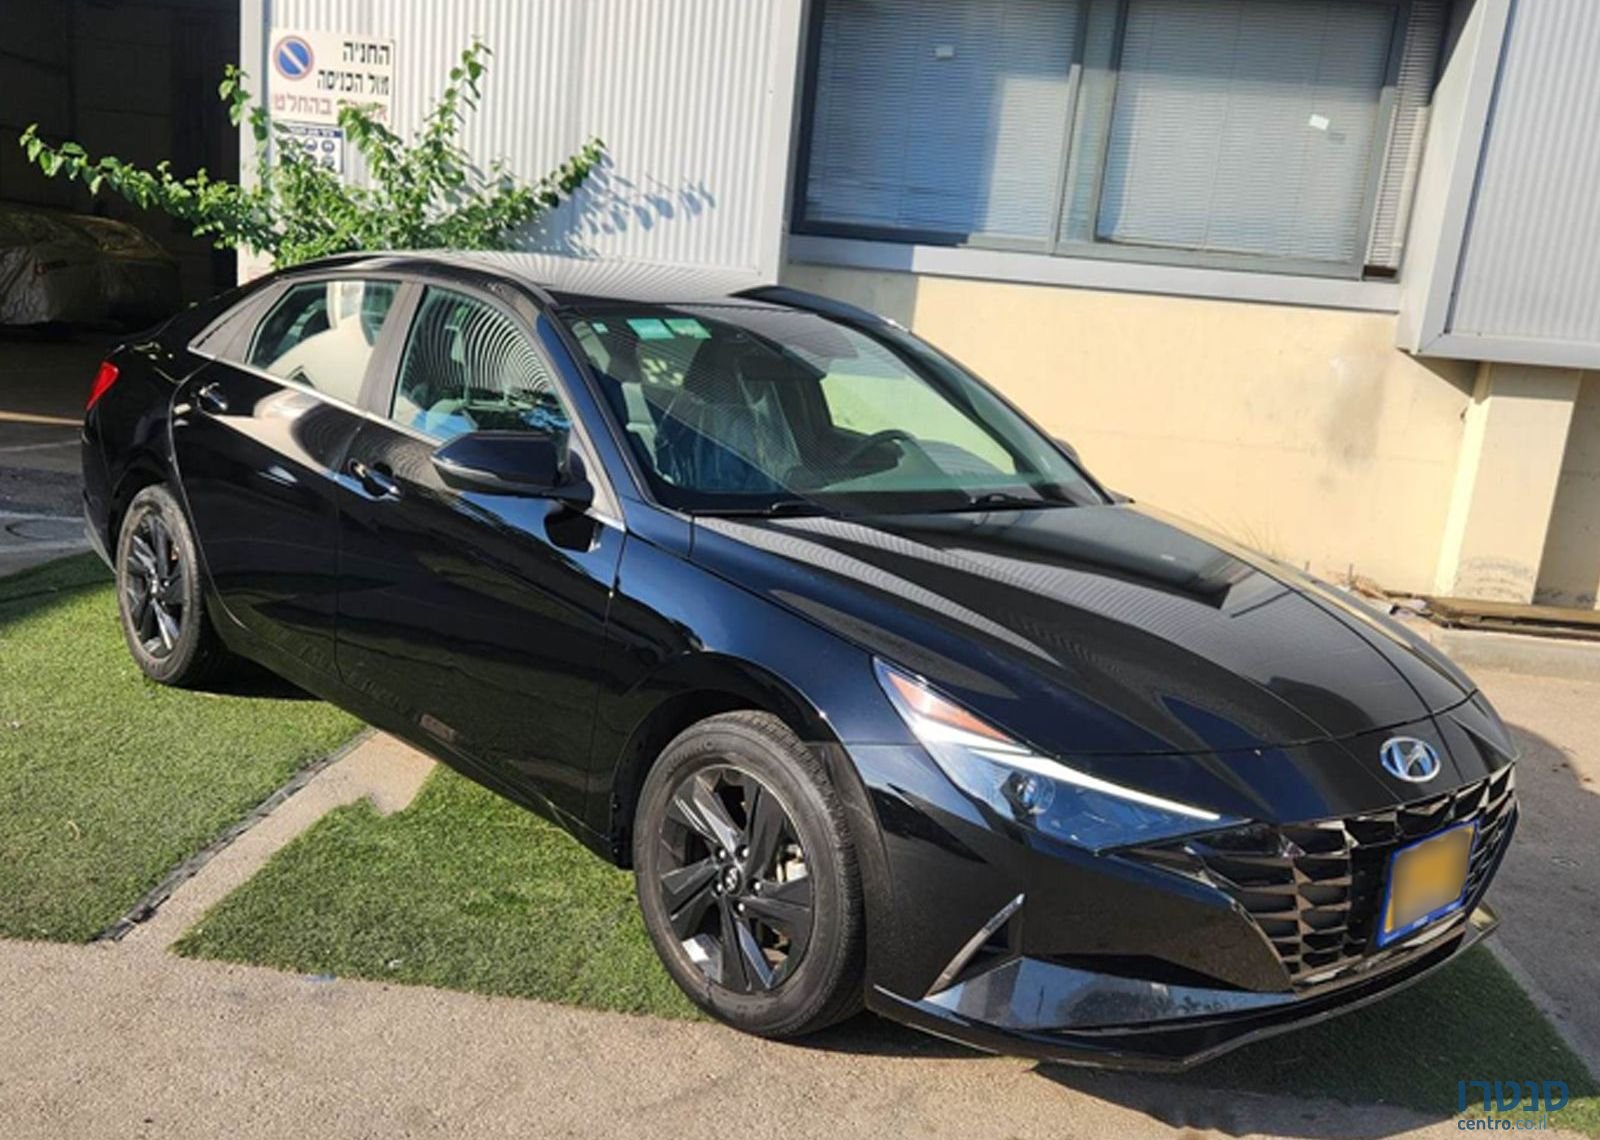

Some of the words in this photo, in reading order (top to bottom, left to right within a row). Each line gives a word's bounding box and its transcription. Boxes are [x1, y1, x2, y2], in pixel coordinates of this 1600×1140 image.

[343, 42, 389, 65] החניה
[317, 69, 363, 93] הכניסה
[274, 92, 332, 115] בהחלט
